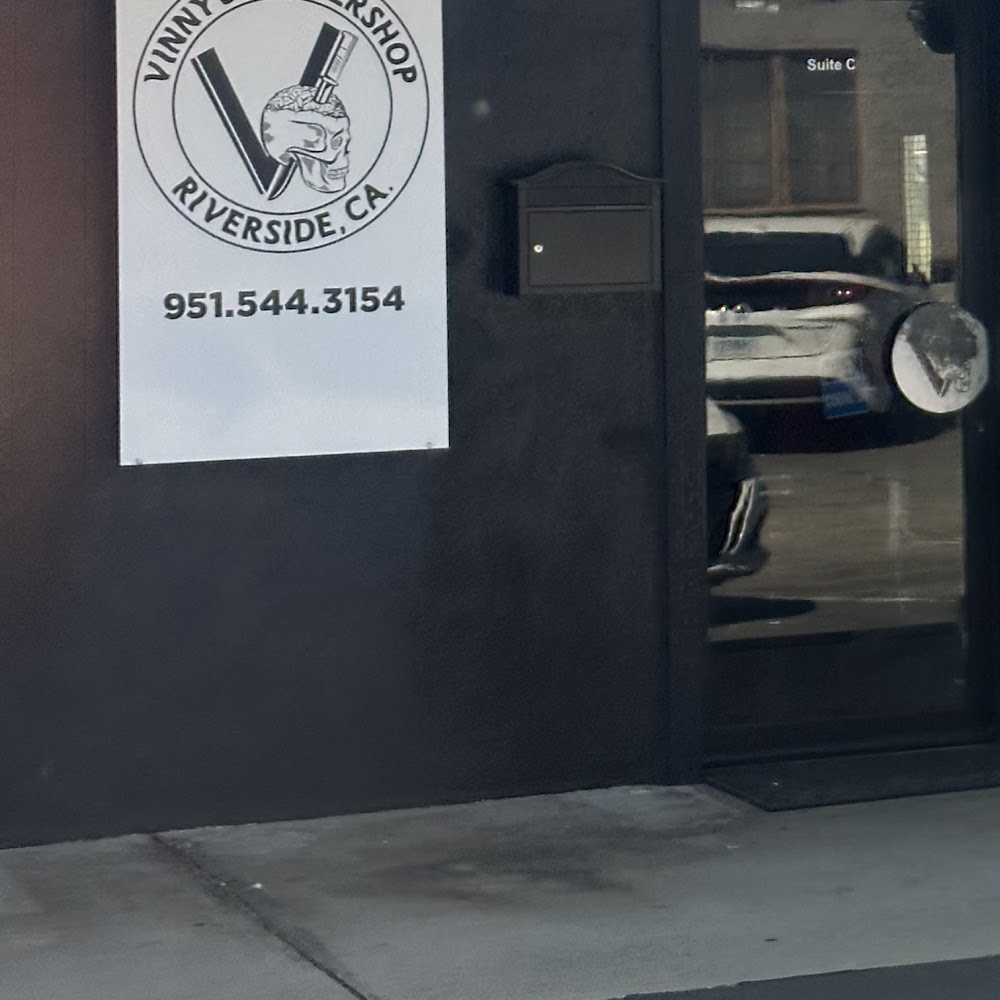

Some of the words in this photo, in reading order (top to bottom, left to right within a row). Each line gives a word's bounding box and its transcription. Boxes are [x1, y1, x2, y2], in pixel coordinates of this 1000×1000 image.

[807, 58, 842, 71] Suite
[845, 58, 856, 70] C
[171, 176, 346, 244] RIVERSIDE,
[345, 186, 394, 221] CA.
[163, 285, 405, 320] 951.544.3154
